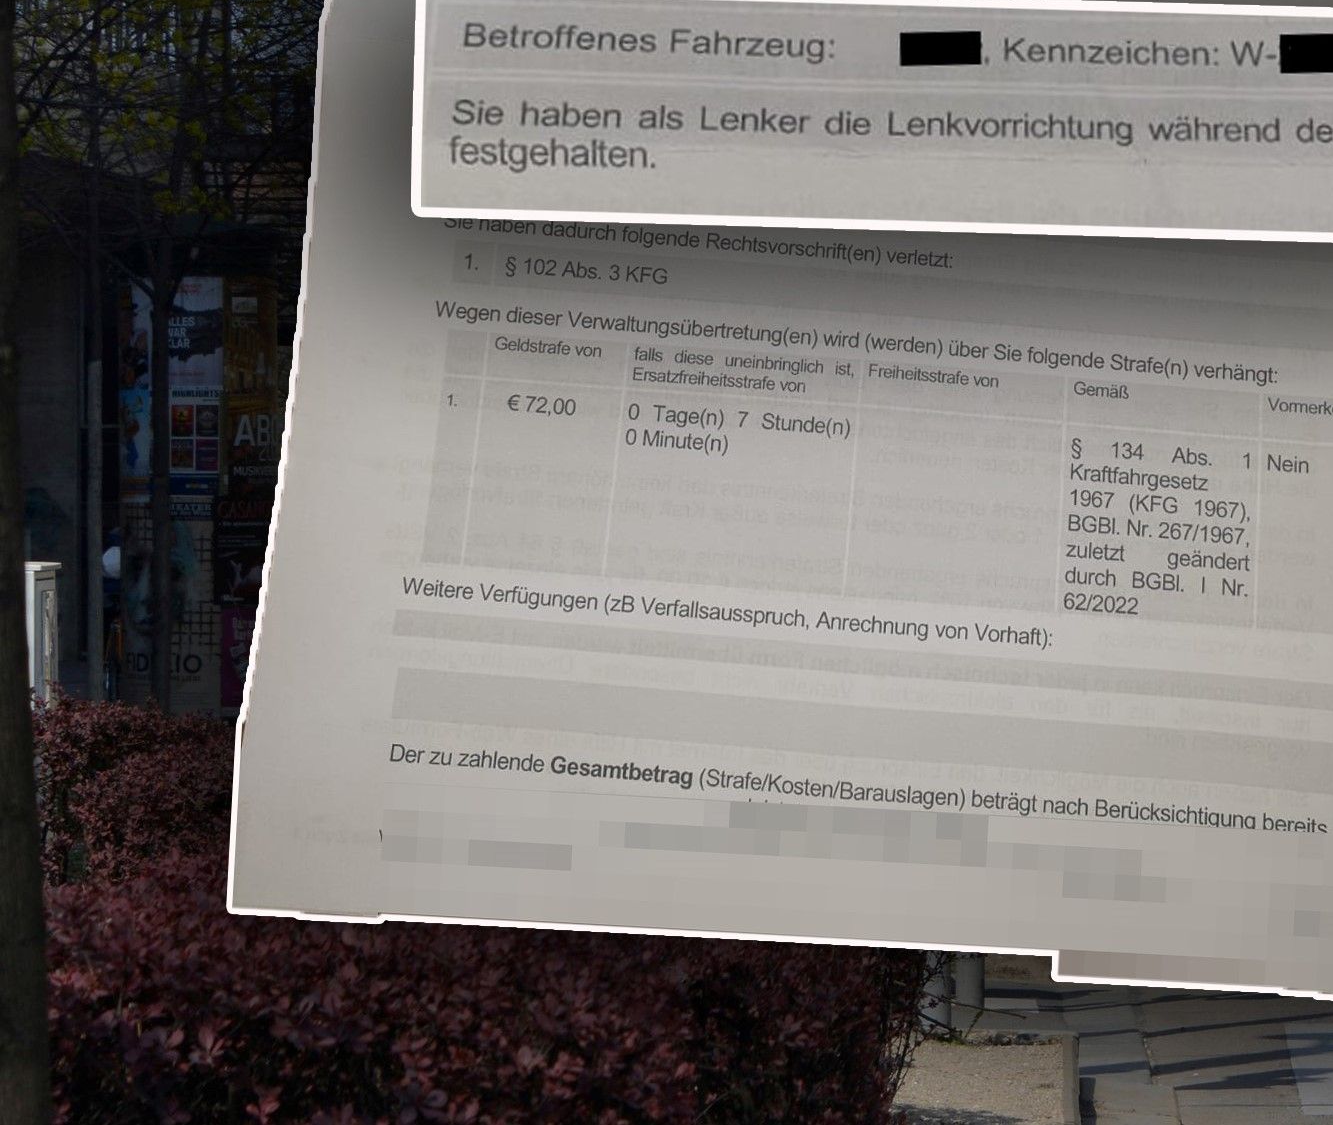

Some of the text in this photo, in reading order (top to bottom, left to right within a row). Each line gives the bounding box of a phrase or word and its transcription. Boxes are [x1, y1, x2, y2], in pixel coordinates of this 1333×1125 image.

[462, 21, 1220, 67] Betroffenes Fahrzeug: Kennzeichen:
[450, 98, 505, 127] Sie
[519, 99, 623, 130] haben
[637, 103, 685, 132] als
[699, 104, 813, 135] Lenker
[823, 109, 872, 137] die
[887, 109, 1134, 148] Lenkvorrichtung
[1147, 115, 1282, 144] während
[447, 134, 657, 175] festgehalten.
[539, 220, 954, 269] dadurch folgende Rechtsvorschrift(en) verletzt:
[523, 257, 668, 285] 102 Abs. KFG
[435, 299, 1280, 388] Wegen dieser Verwaltungsübertretung(en) wird (werden) über Sie folgende Strafe(n) verhängt:
[494, 335, 572, 356] Geldstrafe
[633, 345, 855, 380] falls diese uneinbringlich ist,
[867, 362, 969, 387] Freiheitsstrafe
[631, 366, 807, 394] Ersatzfreiheitsstrafe von
[1073, 380, 1130, 400] Gemäß
[525, 394, 577, 418] 72,00
[652, 403, 851, 441] Tage(n) Stunde(n)
[641, 428, 729, 457] Minute(n)
[1110, 441, 1213, 467] 134 Abs.
[1069, 462, 1209, 493] Kraftfahrgesetz
[1266, 453, 1310, 475] Nein
[1069, 488, 1251, 525] 1967 (KFG 1967),
[1067, 513, 1251, 549] BGBl. Nr. 267/1967,
[1064, 541, 1251, 573] zuletzt geändert
[1064, 565, 1249, 598] durch BGBl. Nr.
[402, 575, 1053, 651] Weitere Verfügungen (zB Verfallsausspruch, Anrechnung von Vorhaft):
[1062, 591, 1139, 618] 62/2022
[388, 743, 427, 765] Der
[427, 750, 453, 767] zu
[456, 749, 546, 774] zahlende
[549, 755, 694, 791] Gesamtbetrag
[697, 768, 967, 810] (Strafe/Kosten/Barauslagen)
[970, 788, 1039, 819] beträgt
[1042, 796, 1089, 817] nach
[1094, 798, 1257, 831] Berücksichtigung
